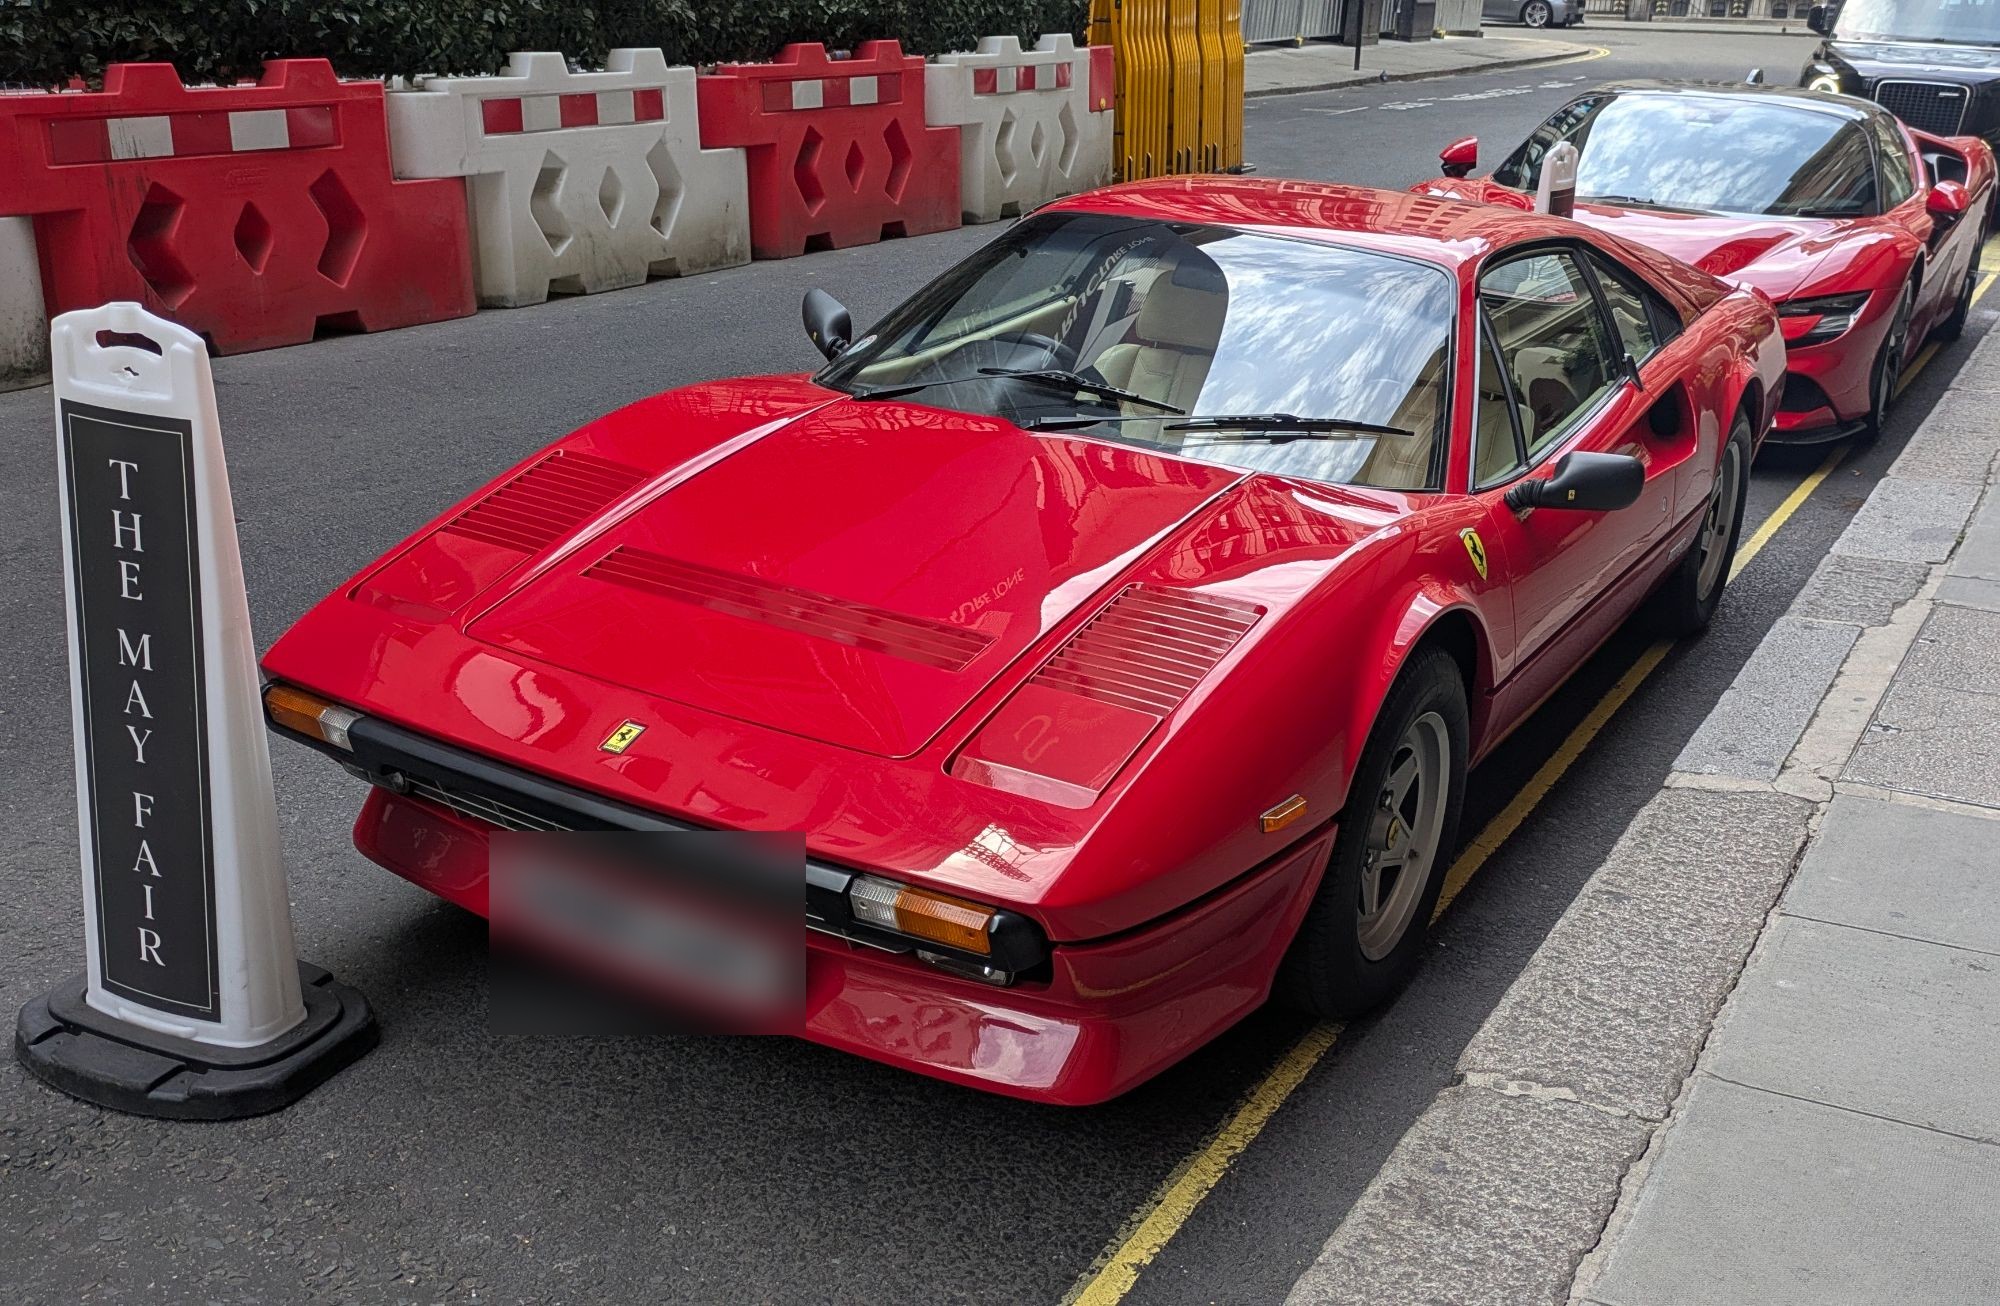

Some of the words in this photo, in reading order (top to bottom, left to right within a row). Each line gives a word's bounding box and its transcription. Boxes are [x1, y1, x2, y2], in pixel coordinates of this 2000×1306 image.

[108, 458, 144, 601] THE
[117, 628, 154, 764] MAY
[132, 791, 166, 967] FAIR
